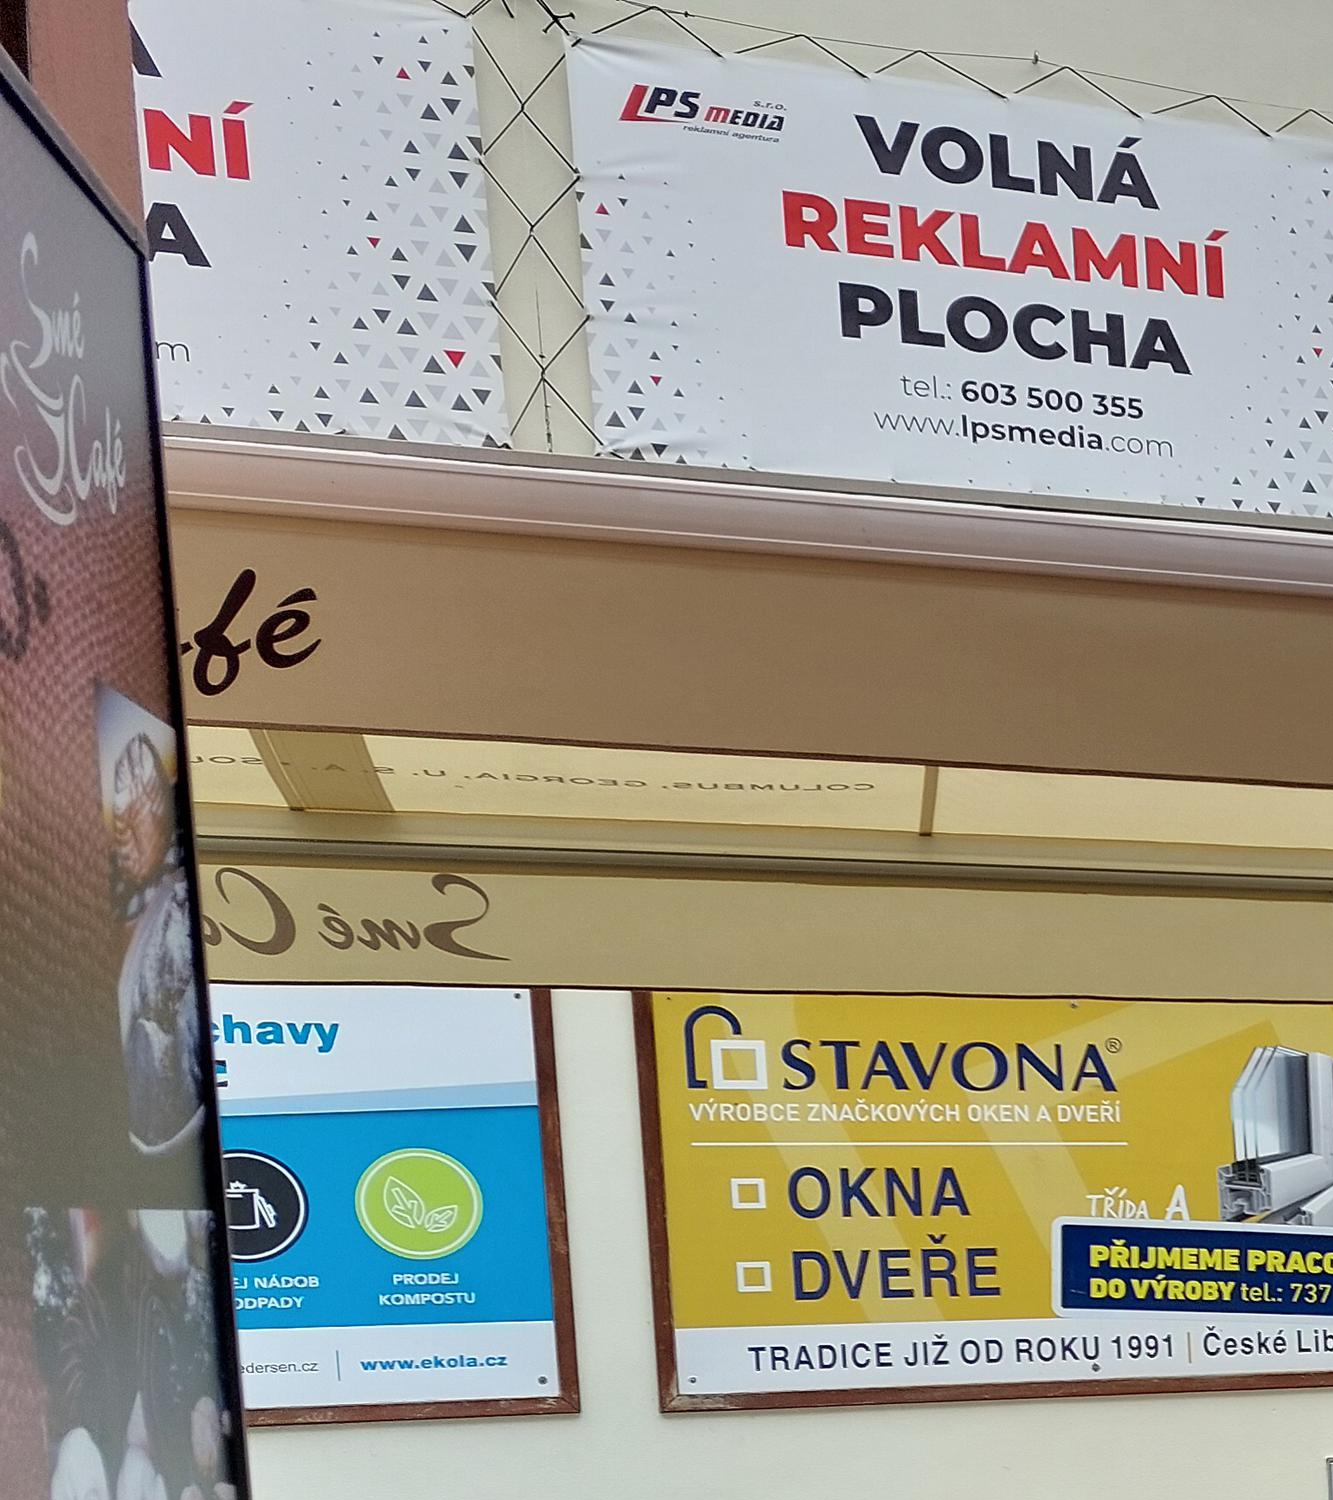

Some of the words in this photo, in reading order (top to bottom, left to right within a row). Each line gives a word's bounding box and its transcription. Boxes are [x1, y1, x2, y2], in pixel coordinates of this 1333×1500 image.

[619, 84, 701, 123] LPS
[683, 124, 729, 136] reklamní
[732, 131, 780, 143] agentura
[855, 114, 1160, 210] VOLNÁ
[782, 190, 1229, 298] REKLAMNÍ
[840, 283, 1192, 375] PLOCHA
[901, 375, 952, 401] tel.:
[961, 380, 1017, 407] 603
[1028, 387, 1083, 413] 500
[1093, 394, 1144, 420] 355
[875, 409, 1174, 458] www.lpsmedia.com
[181, 568, 322, 696] fé
[781, 1039, 1118, 1092] STAVONA
[688, 1097, 801, 1122] VÝROBCE
[807, 1098, 961, 1122] ZNAČKOVÝCH
[967, 1104, 1030, 1122] OKEN
[1036, 1104, 1052, 1122] A
[1057, 1100, 1121, 1122] DVEŘÍ
[788, 1166, 971, 1219] OKNA
[1085, 1186, 1149, 1220] TŘÍDA
[792, 1233, 1001, 1301] DVEŘE
[1089, 1239, 1241, 1273] PŘIJMEME
[254, 1275, 320, 1289] NÁDOB
[393, 1273, 459, 1285] PRODEJ
[1090, 1278, 1125, 1299] DO
[1130, 1274, 1235, 1302] VÝROBY
[1241, 1282, 1283, 1303] tel.:
[1289, 1283, 1331, 1303] 737
[379, 1293, 476, 1306] KOMPOSTU
[240, 1361, 319, 1374] edersen.cz
[360, 1354, 508, 1371] www.ekola.cz
[748, 1342, 893, 1371] TRADICE
[904, 1333, 950, 1367] JIŽ
[960, 1339, 1003, 1365] OD
[1015, 1336, 1100, 1362] ROKU
[1110, 1334, 1173, 1359] 1991
[1203, 1326, 1287, 1356] České
